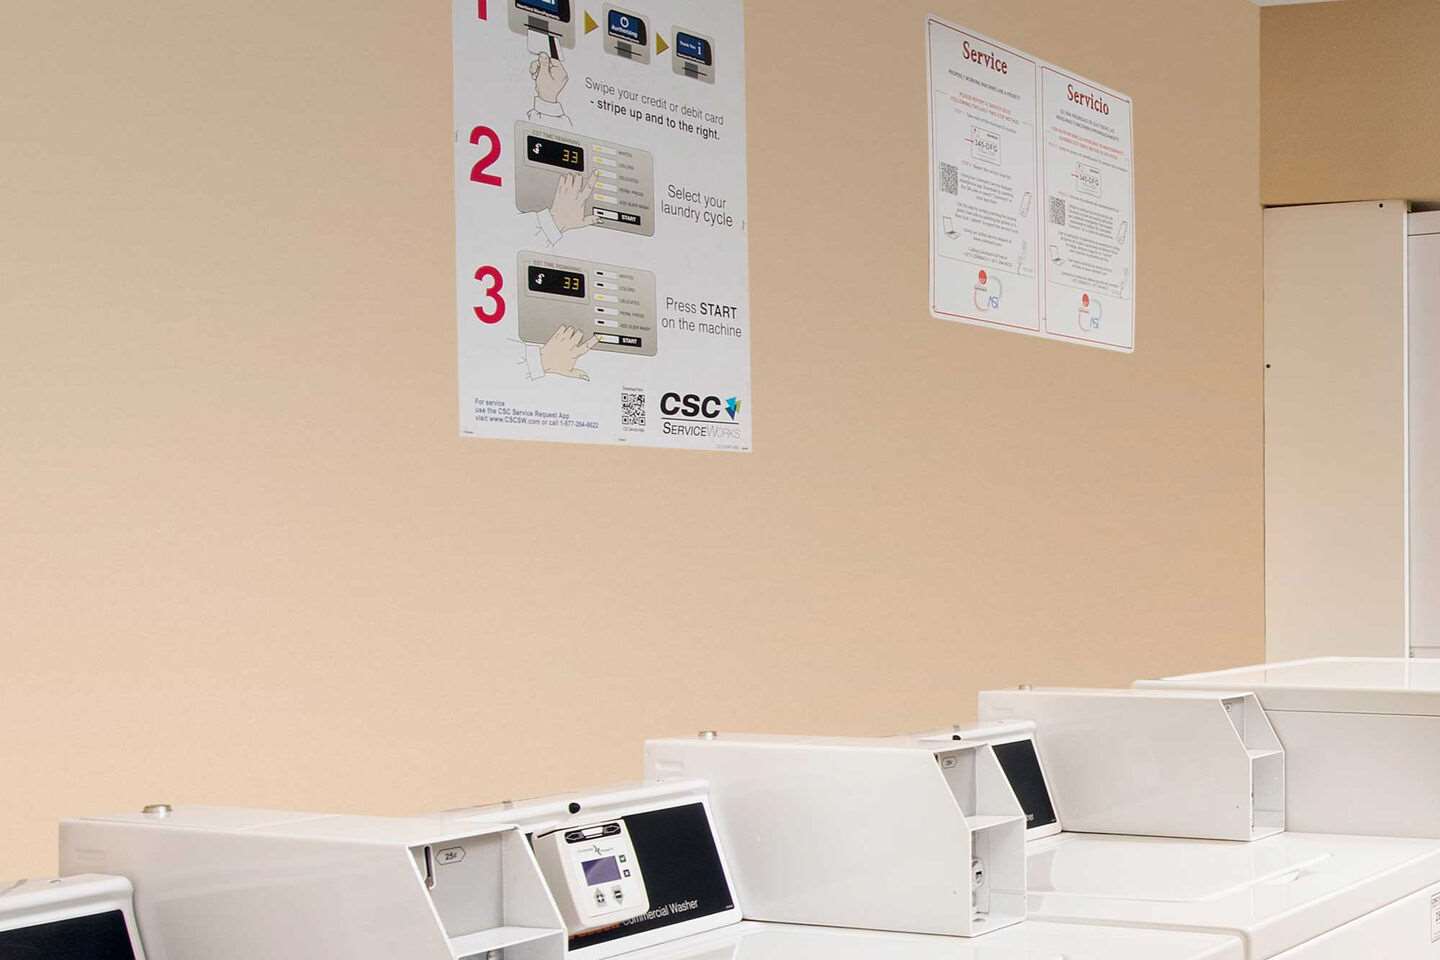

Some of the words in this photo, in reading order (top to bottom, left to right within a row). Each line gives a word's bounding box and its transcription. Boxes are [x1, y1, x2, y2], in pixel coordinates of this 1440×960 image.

[962, 40, 1008, 75] Service
[585, 77, 615, 95] Swipe
[617, 88, 638, 101] your
[641, 94, 667, 109] credit
[669, 103, 679, 112] or
[681, 104, 703, 120] debit
[704, 112, 724, 125] card
[1067, 83, 1110, 115] Servicio
[597, 99, 627, 115] stripe
[630, 108, 642, 121] up
[645, 112, 664, 125] and
[666, 117, 676, 128] to
[678, 120, 694, 133] the
[696, 125, 720, 140] right.
[469, 125, 502, 187] 2
[561, 149, 579, 163] 33
[668, 184, 700, 203] Select
[704, 195, 726, 208] your
[661, 200, 700, 223] laundry
[703, 211, 733, 227] cycle
[472, 265, 506, 324] 3
[562, 276, 580, 290] 33
[666, 297, 697, 313] Press
[700, 302, 737, 319] START
[661, 317, 675, 328] on
[679, 317, 695, 331] the
[699, 321, 742, 338] machine
[474, 397, 484, 405] For
[485, 399, 505, 407] service
[487, 407, 497, 415] the
[498, 407, 511, 415] CSC
[512, 408, 534, 417] Service
[535, 410, 558, 419] Request
[660, 392, 721, 419] CSC
[669, 899, 698, 915] Washer
